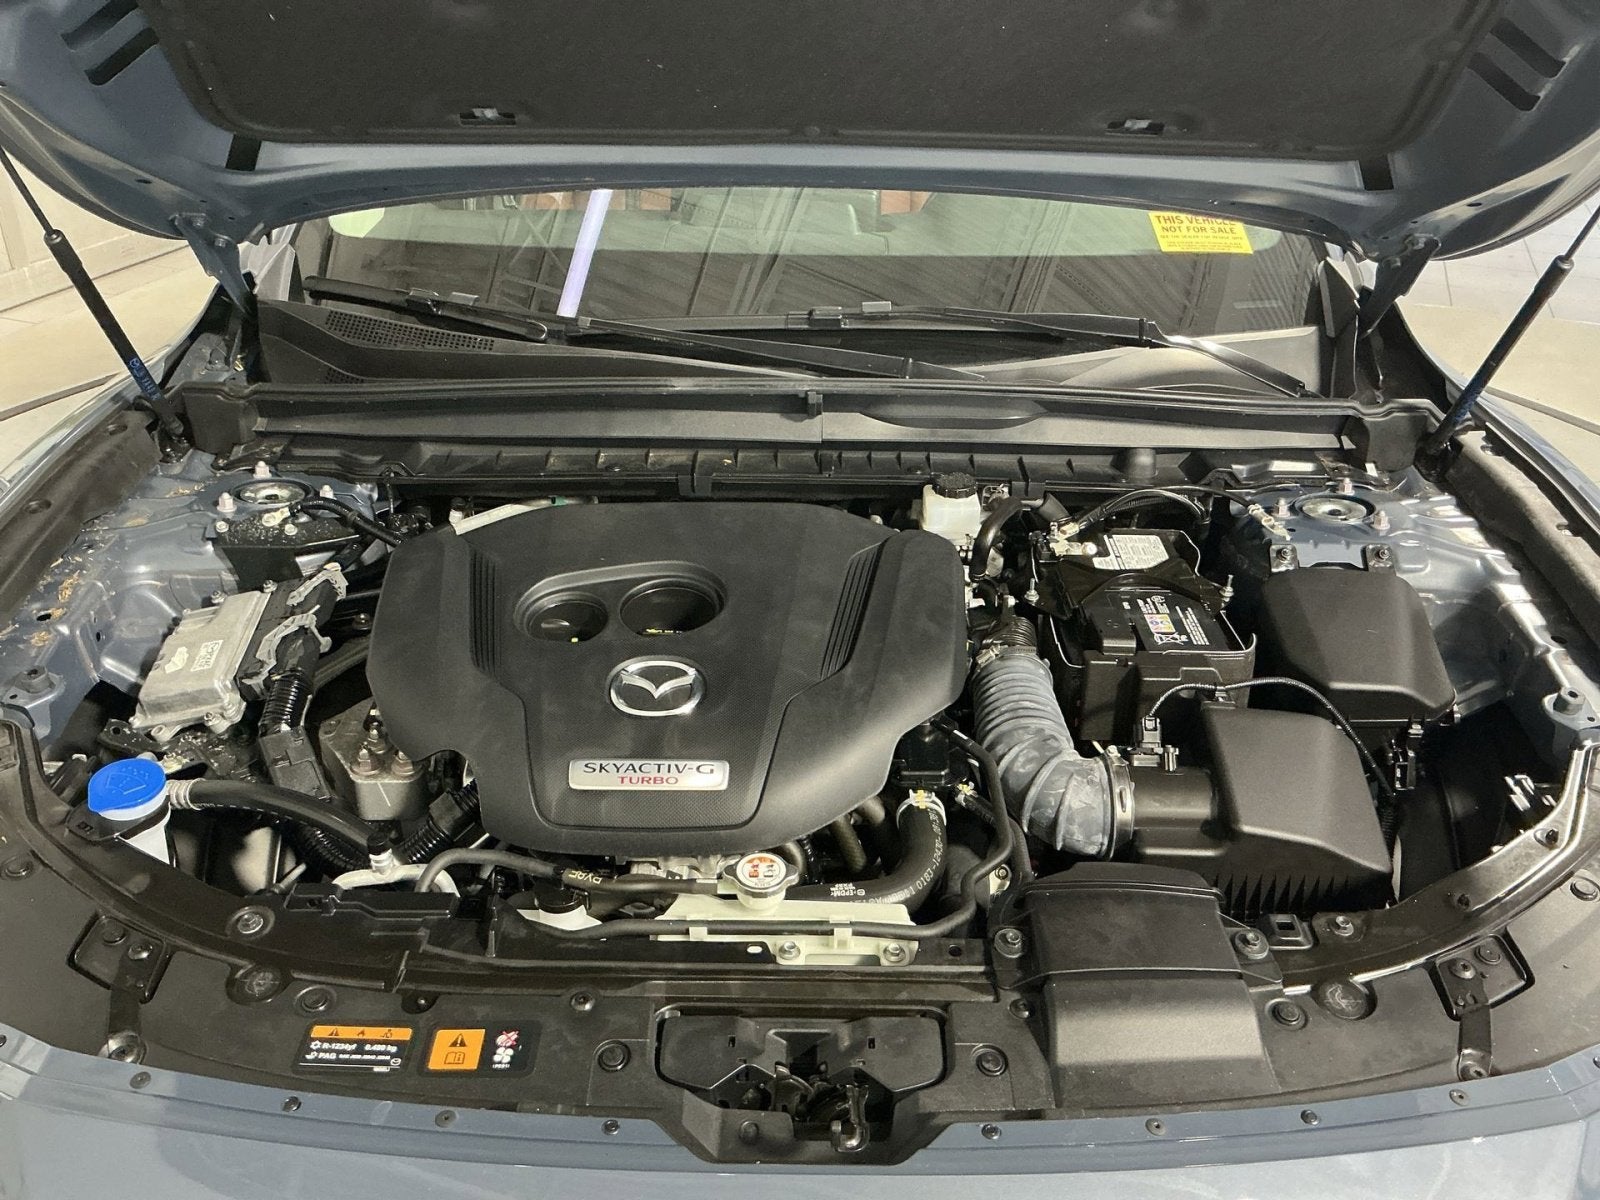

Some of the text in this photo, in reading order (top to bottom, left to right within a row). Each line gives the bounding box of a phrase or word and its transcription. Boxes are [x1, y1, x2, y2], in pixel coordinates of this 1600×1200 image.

[1155, 215, 1183, 224] THIS
[1161, 225, 1237, 235] NOT FOR SALE
[583, 762, 715, 775] SKYACTIV-G
[618, 776, 679, 785] TURBO
